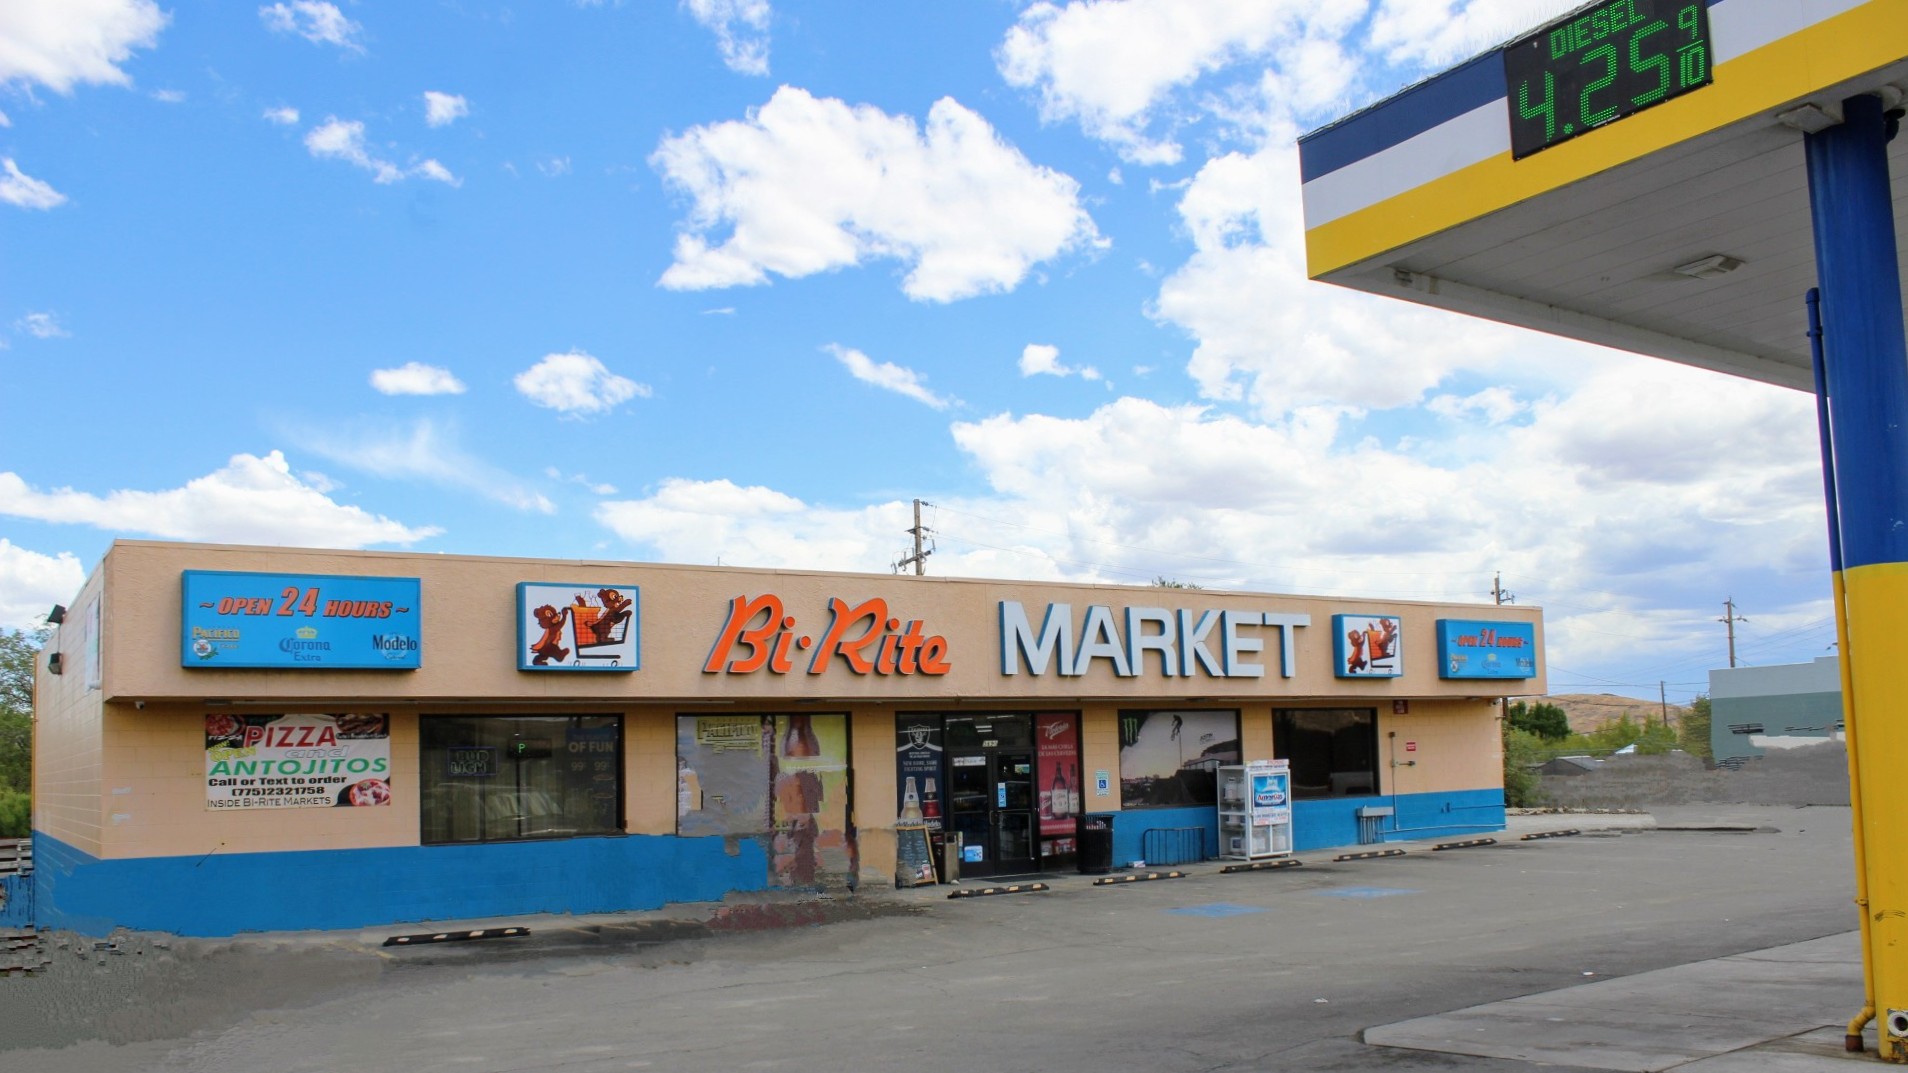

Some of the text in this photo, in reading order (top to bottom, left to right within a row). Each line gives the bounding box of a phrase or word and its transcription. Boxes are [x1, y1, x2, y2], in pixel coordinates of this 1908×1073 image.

[1551, 0, 1645, 59] DIESEL
[1677, 5, 1698, 40] 9
[1680, 45, 1705, 88] 10
[1519, 20, 1670, 142] 4.25
[218, 587, 394, 618] OPEN 24 HOURS
[279, 638, 331, 653] Corona
[372, 634, 418, 651] Modelo
[999, 601, 1311, 677] MARKET
[1479, 628, 1496, 647] 24
[293, 652, 321, 661] Extra
[243, 725, 336, 747] PIZZA
[285, 745, 350, 759] and
[568, 741, 615, 753] OF FUN
[208, 757, 387, 776] ANTOJITOS
[208, 777, 237, 786] Call
[258, 777, 289, 786] Text
[291, 777, 305, 785] to
[308, 775, 347, 784] order
[207, 799, 240, 808] INSIDE
[283, 796, 331, 806] MARKETS
